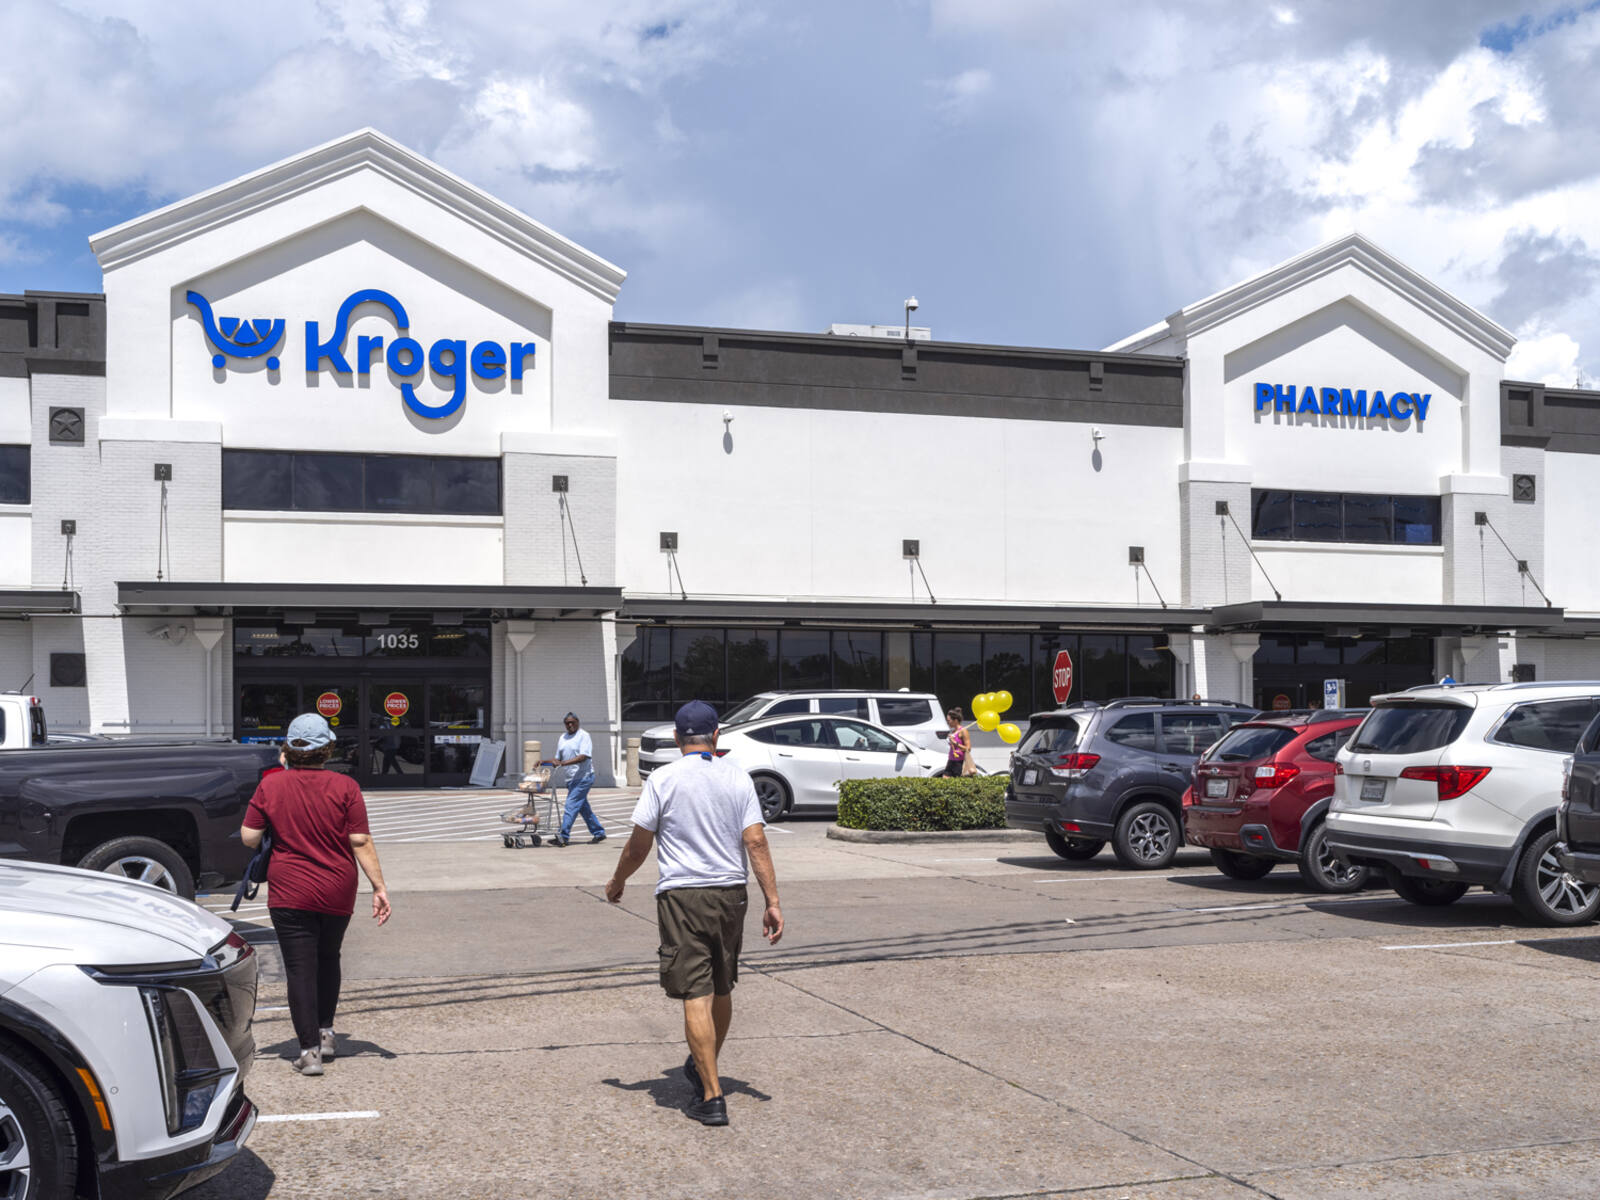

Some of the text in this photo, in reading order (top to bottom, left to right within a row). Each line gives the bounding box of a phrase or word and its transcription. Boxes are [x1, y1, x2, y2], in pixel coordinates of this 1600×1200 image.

[305, 289, 536, 419] Kroger
[1255, 382, 1432, 421] PHARMACY
[377, 634, 419, 649] 1035
[1055, 667, 1071, 688] STOP
